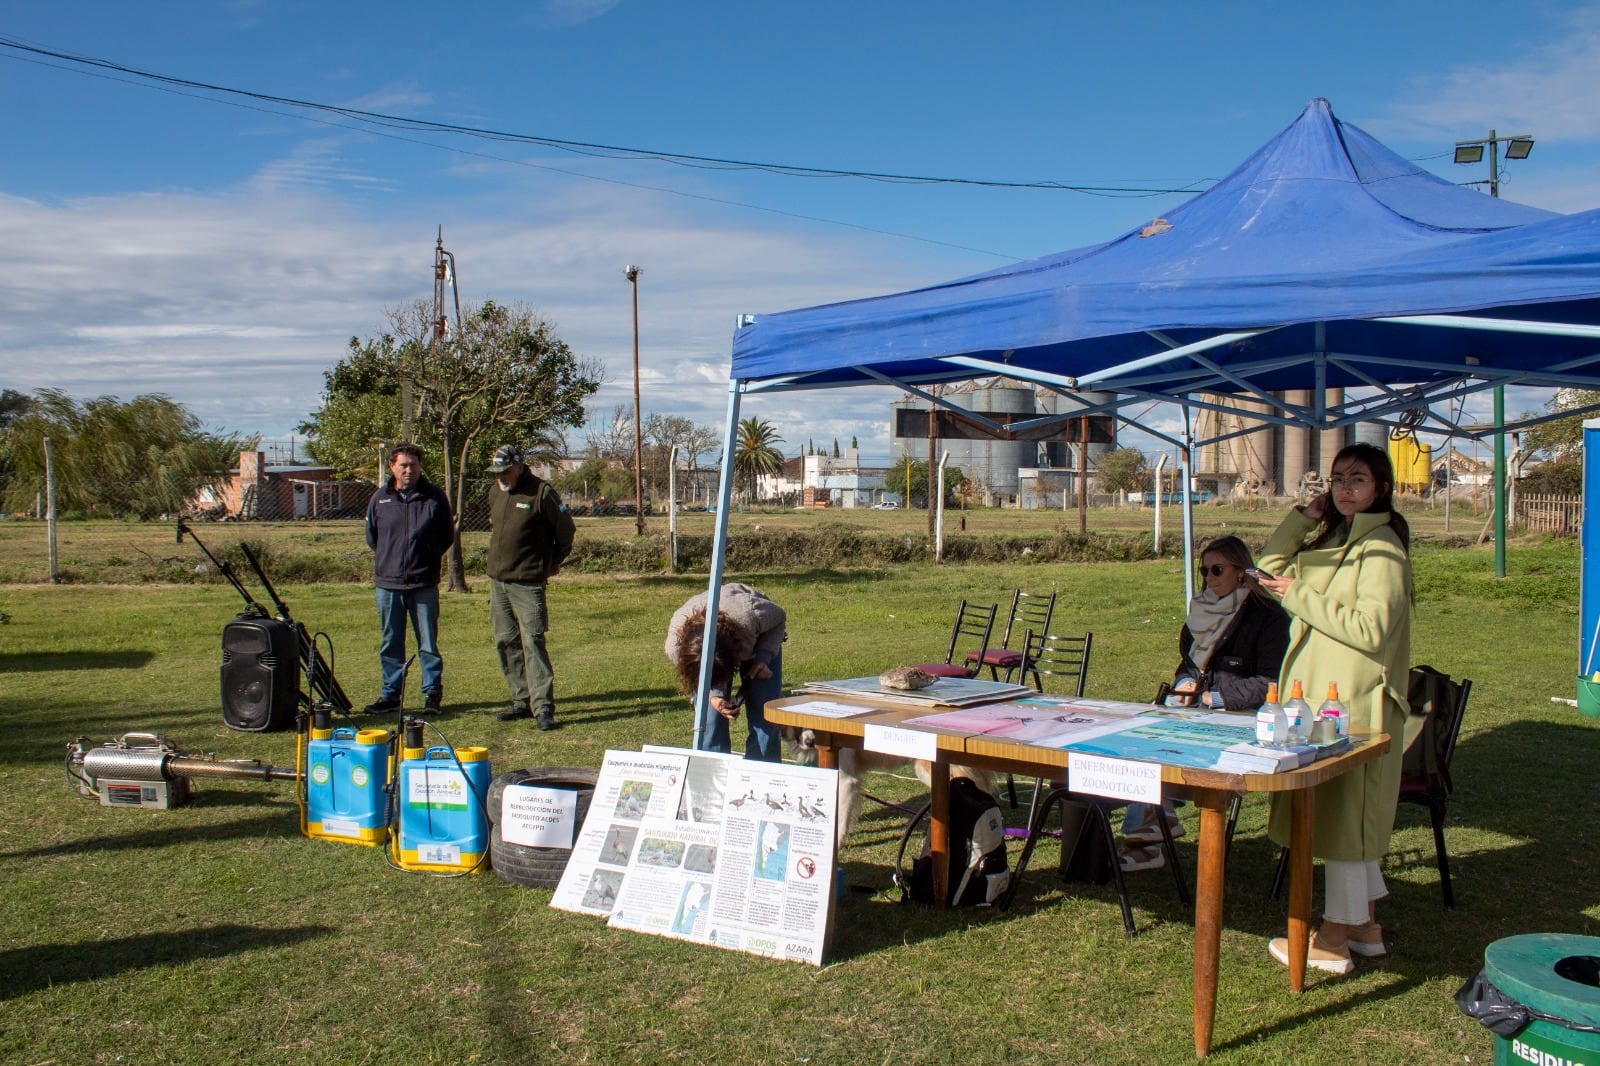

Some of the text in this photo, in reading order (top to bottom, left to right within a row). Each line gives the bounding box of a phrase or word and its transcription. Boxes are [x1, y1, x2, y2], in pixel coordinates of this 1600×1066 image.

[884, 731, 917, 745] DENGUE
[1074, 759, 1157, 779] ENFERMEDADES
[1082, 776, 1147, 796] ZOONOTICAS
[519, 795, 544, 804] LUGARES
[511, 812, 540, 822] MOSQUITO
[679, 832, 707, 844] NATURAL
[755, 938, 777, 950] OPDS
[785, 943, 813, 956] AZARA
[1512, 1038, 1586, 1066] RESIDU
